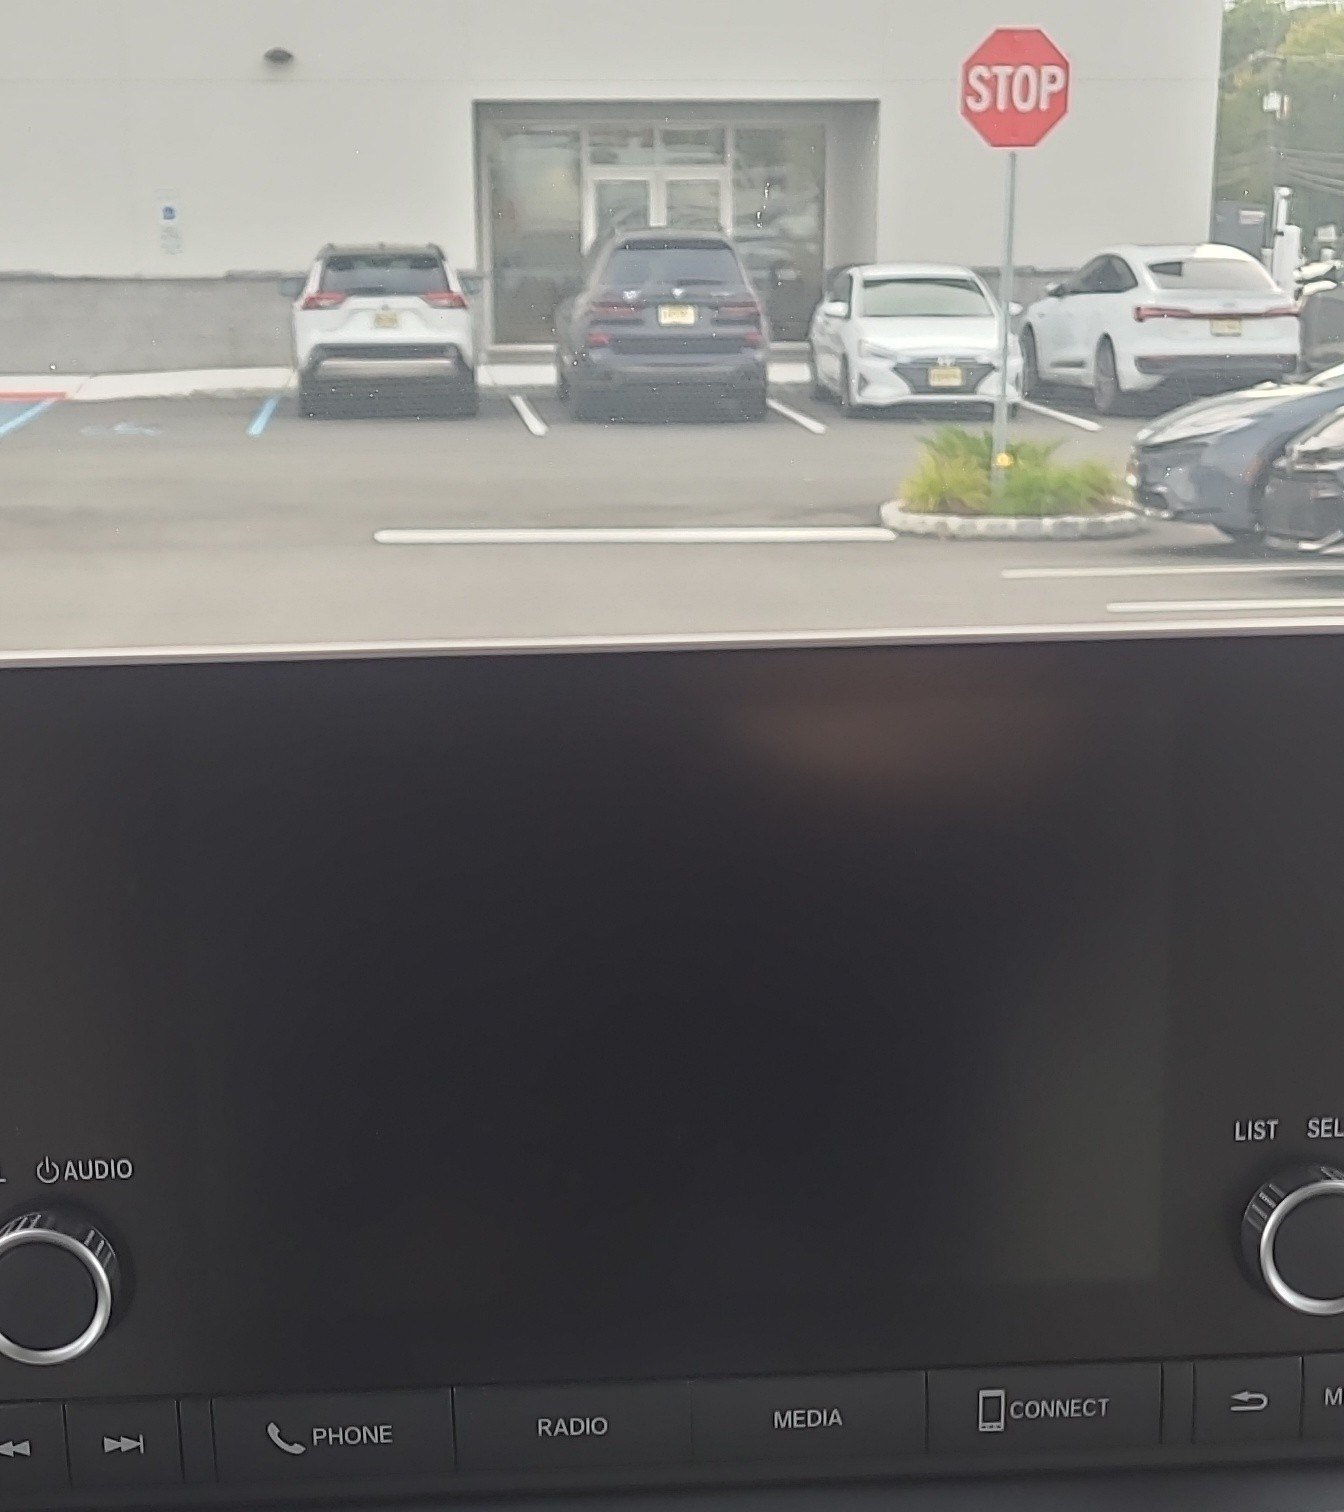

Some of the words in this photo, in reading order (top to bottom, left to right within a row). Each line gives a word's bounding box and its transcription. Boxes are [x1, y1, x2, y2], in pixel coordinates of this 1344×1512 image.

[966, 64, 1065, 113] STOP
[1235, 1118, 1279, 1141] LIST
[64, 1158, 133, 1181] AUDIO
[774, 1408, 843, 1429] MEDIA
[1009, 1398, 1110, 1419] CONNECT
[312, 1425, 393, 1446] PHONE
[538, 1417, 608, 1437] RADIO
